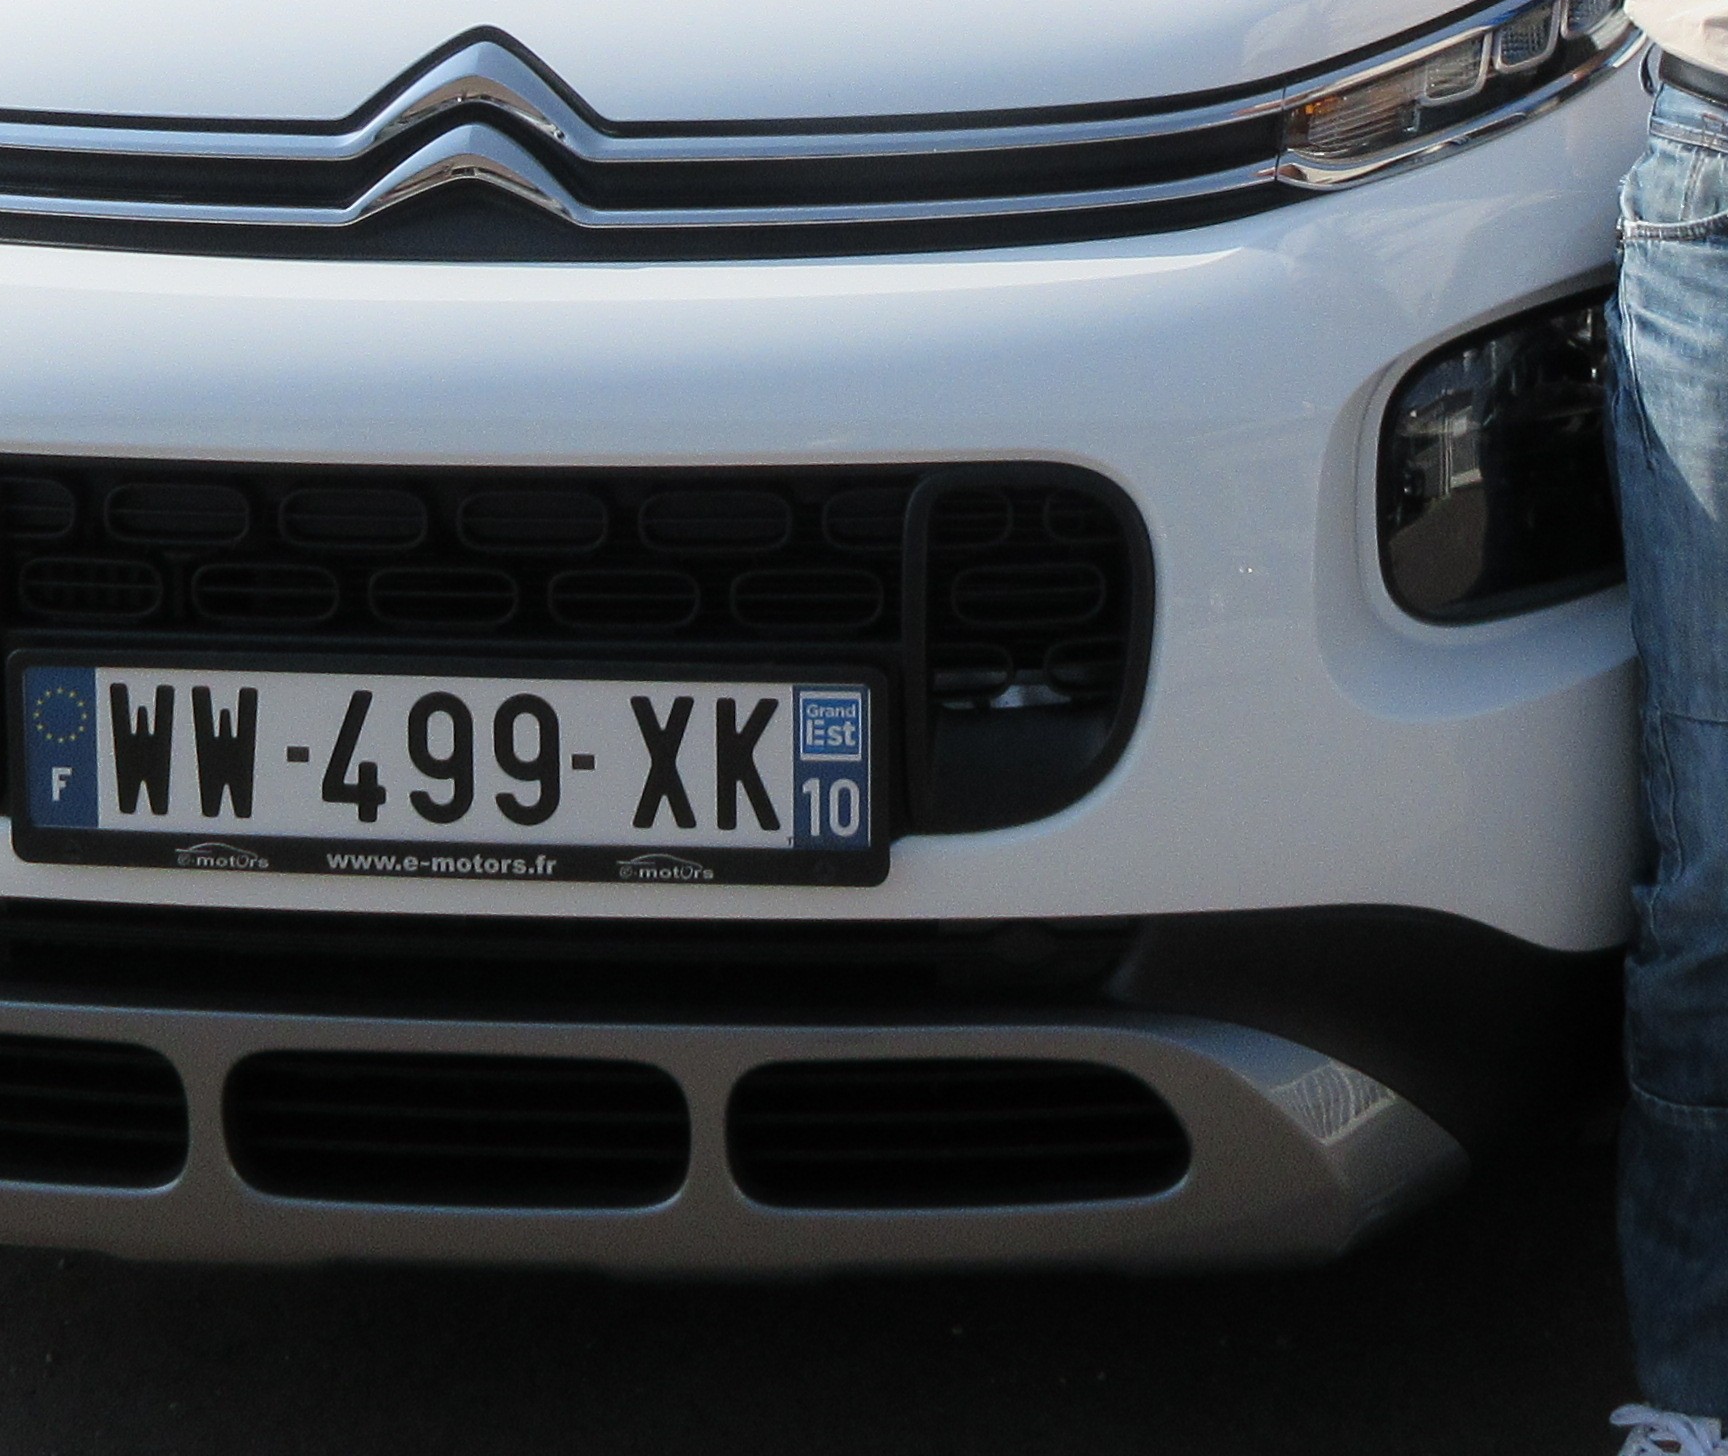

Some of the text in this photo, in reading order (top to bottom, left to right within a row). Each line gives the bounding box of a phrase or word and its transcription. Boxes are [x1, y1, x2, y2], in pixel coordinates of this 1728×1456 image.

[806, 703, 856, 718] Grand
[806, 719, 856, 746] Est
[51, 766, 71, 802] F
[802, 777, 860, 837] 10
[326, 850, 557, 877] www.e-motors.fr
